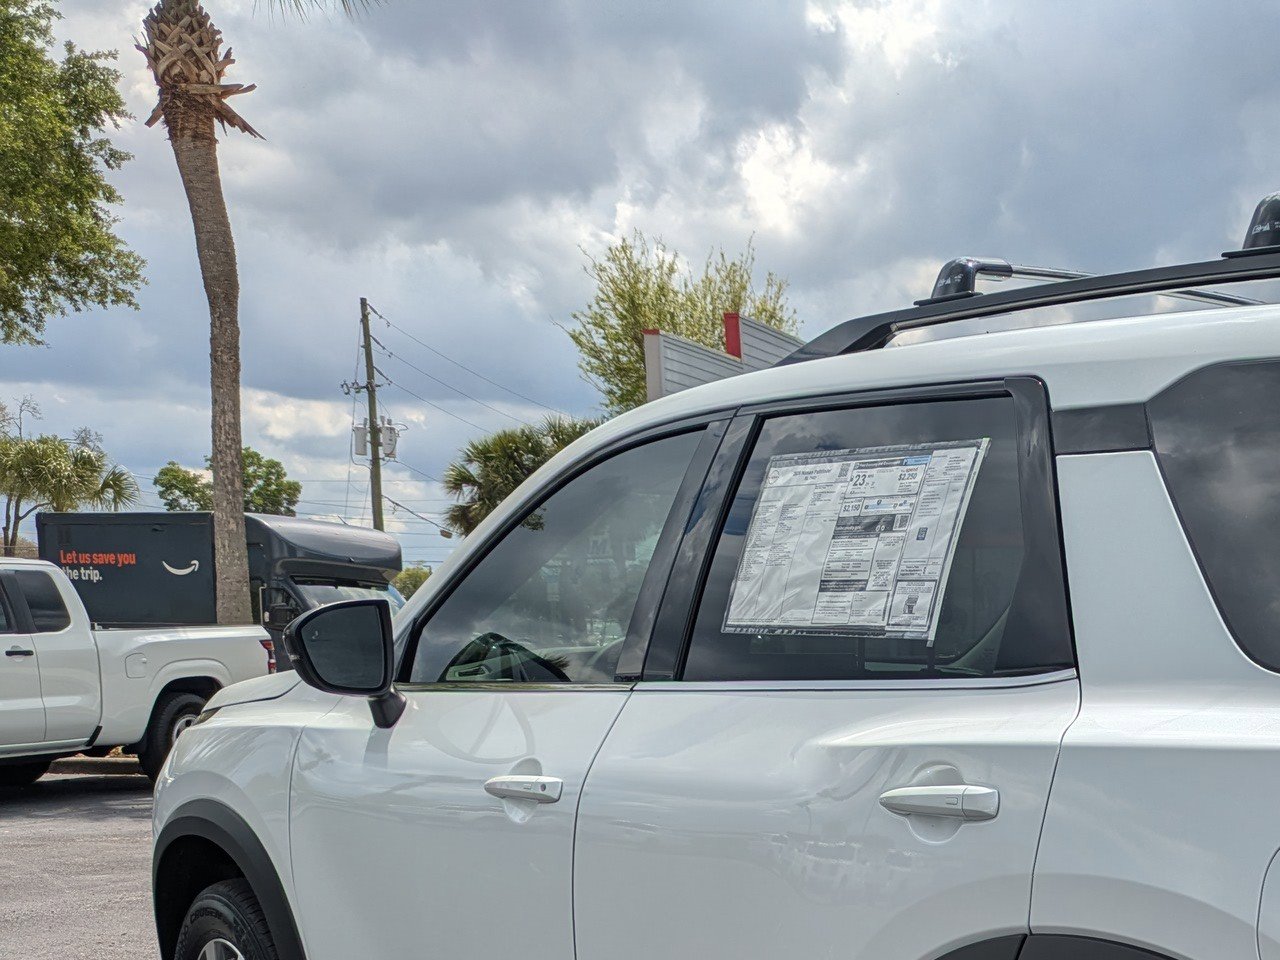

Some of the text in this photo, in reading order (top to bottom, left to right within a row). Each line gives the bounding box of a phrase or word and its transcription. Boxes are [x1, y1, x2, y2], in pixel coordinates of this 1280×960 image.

[60, 549, 136, 568] Let us save you
[80, 566, 103, 583] trip.
